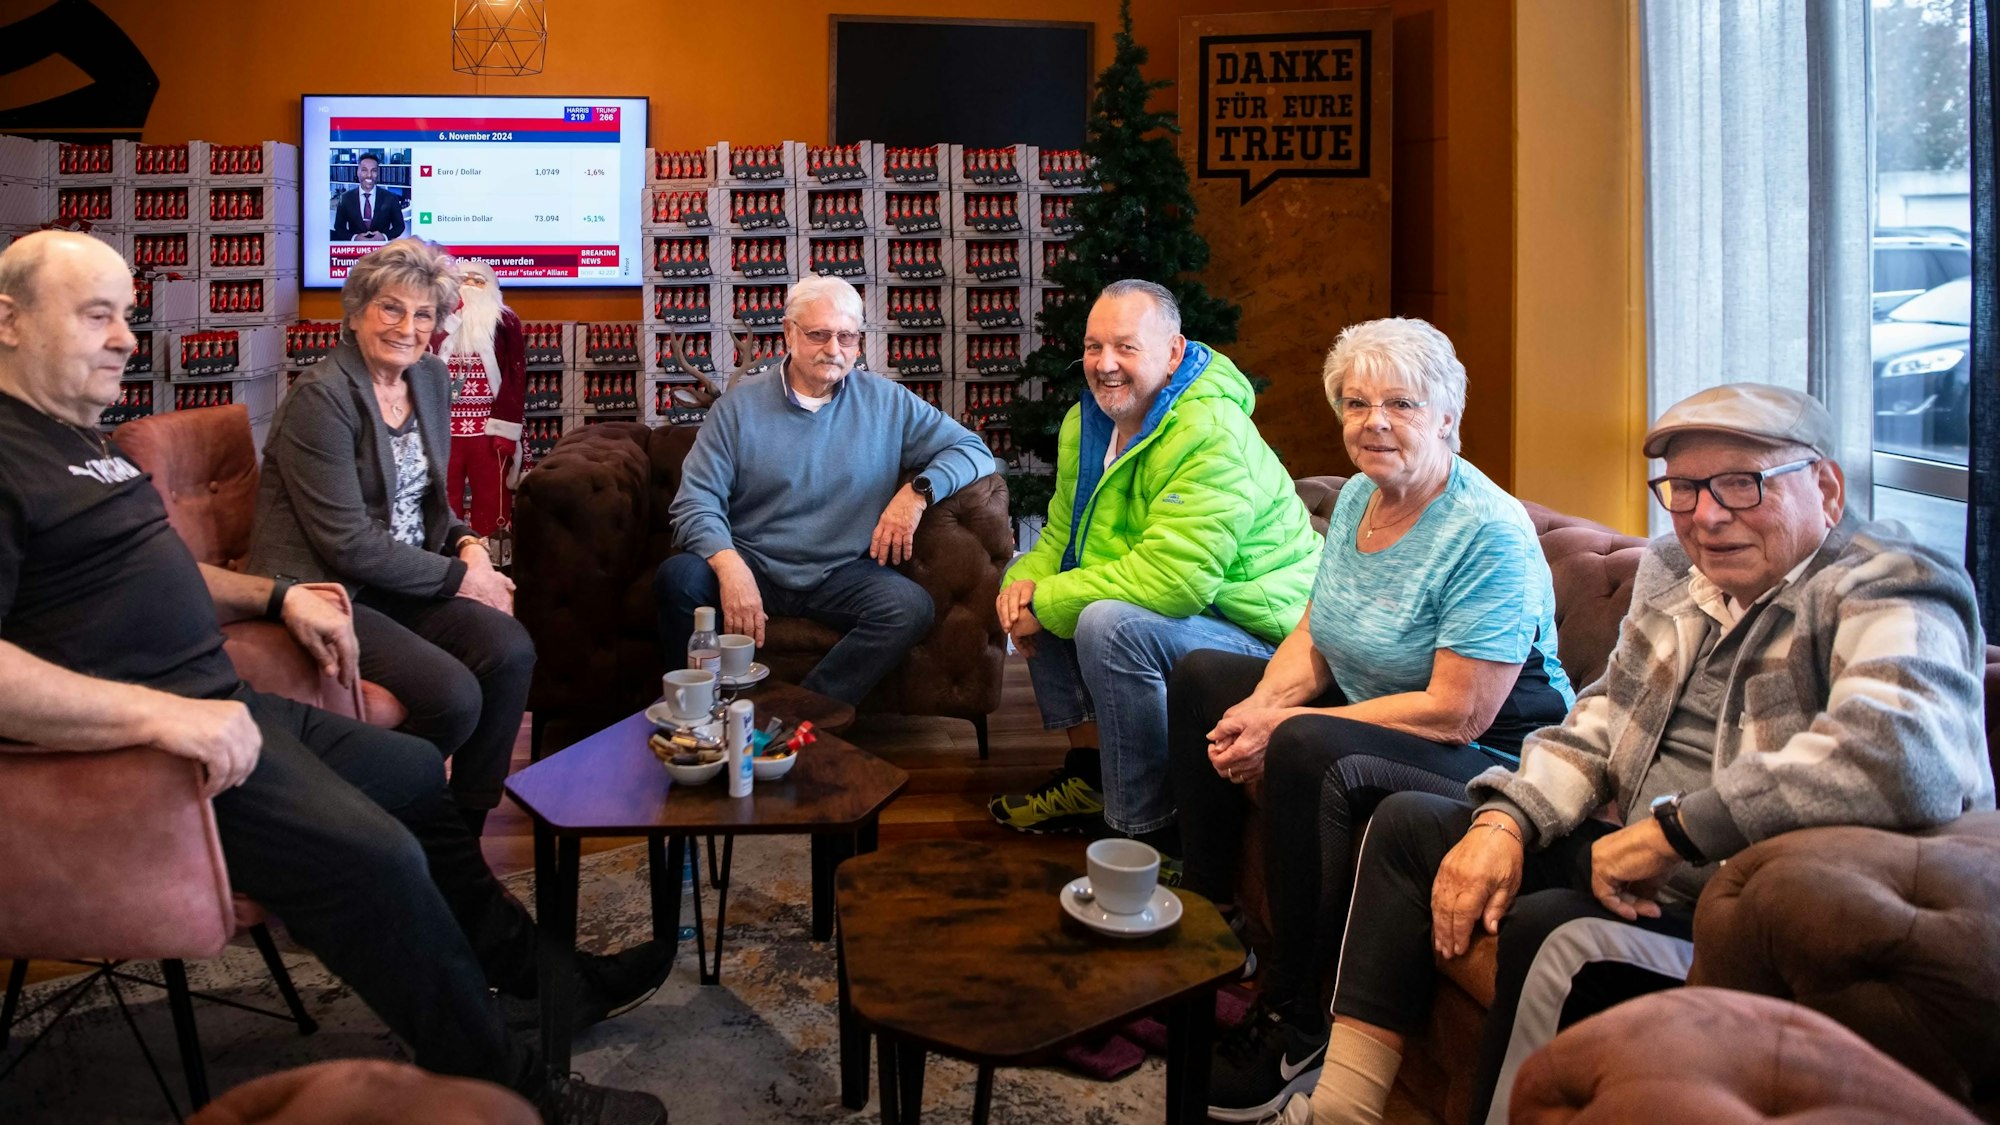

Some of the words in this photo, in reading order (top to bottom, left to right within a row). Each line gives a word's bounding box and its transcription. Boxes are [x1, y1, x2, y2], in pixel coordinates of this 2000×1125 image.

[1216, 48, 1353, 84] DANKE
[1216, 91, 1268, 119] FÜR
[1282, 94, 1353, 118] EURE
[570, 113, 586, 121] 219
[599, 113, 614, 121] 266
[439, 131, 448, 140] 6.
[449, 131, 491, 140] November
[491, 132, 513, 140] 2024
[1215, 124, 1353, 161] TREUE
[535, 168, 560, 176] 1,0749
[583, 168, 605, 176] -1,6%
[583, 215, 606, 223] +5,1%
[581, 249, 617, 257] BREAKING
[502, 256, 535, 266] werden
[581, 257, 602, 265] NEWS
[331, 269, 346, 277] ntv
